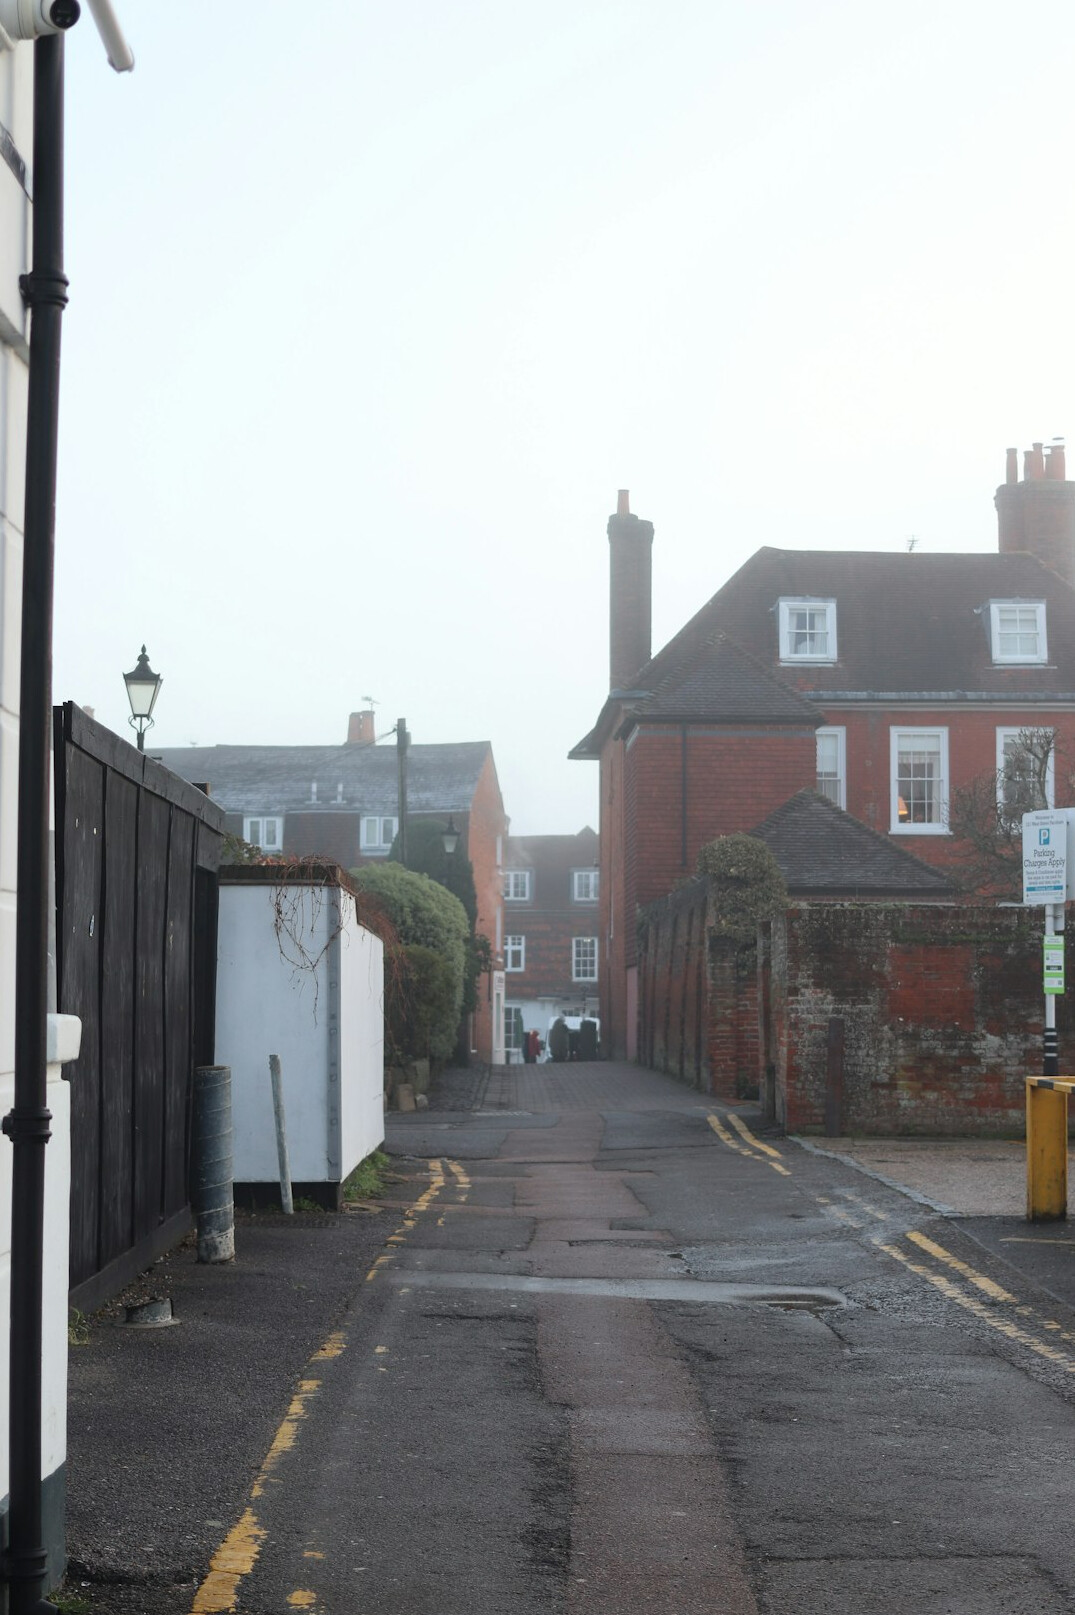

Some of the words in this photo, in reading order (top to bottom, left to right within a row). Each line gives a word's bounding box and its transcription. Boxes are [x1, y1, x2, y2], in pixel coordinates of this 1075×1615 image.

[1041, 829, 1049, 845] P
[1034, 849, 1055, 858] Parking
[1024, 859, 1047, 869] Charges
[1048, 858, 1065, 868] Apply
